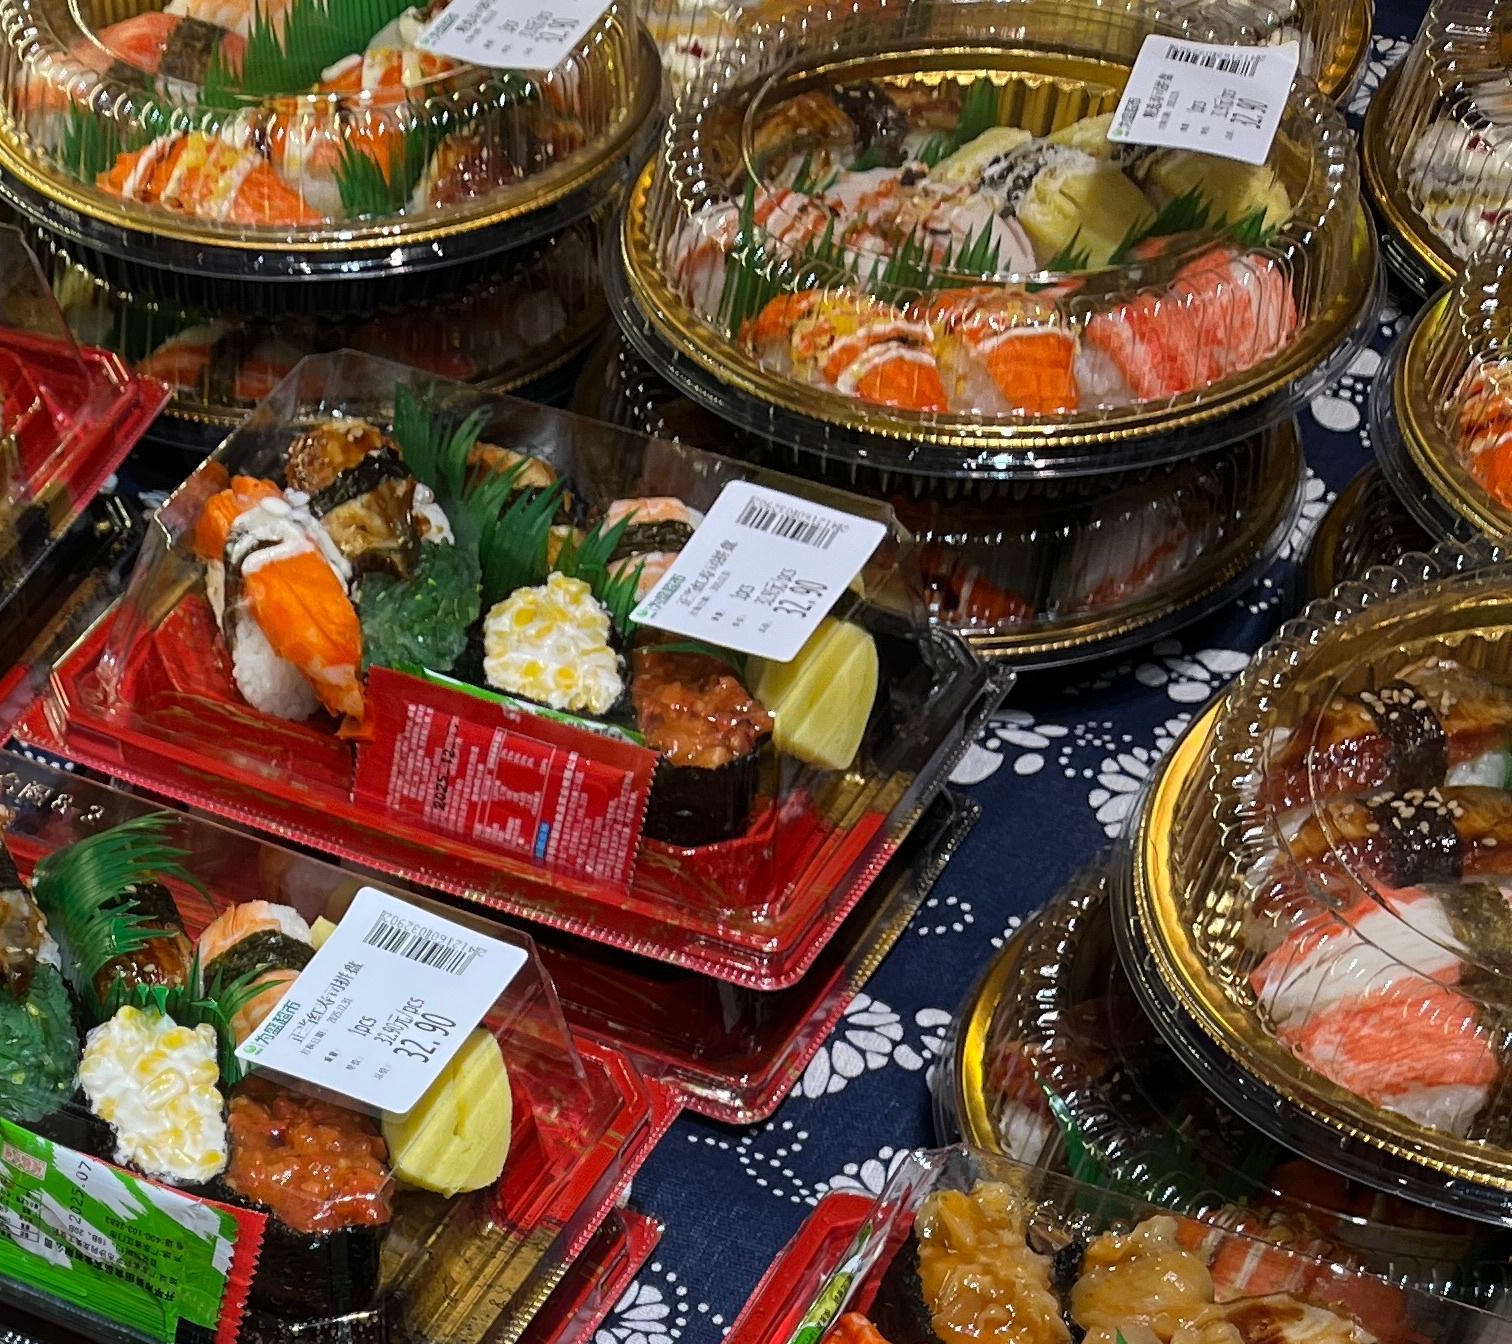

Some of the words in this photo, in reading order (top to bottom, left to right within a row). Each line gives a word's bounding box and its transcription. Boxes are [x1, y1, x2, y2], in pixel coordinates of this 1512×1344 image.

[253, 998, 301, 1045] 为盛超市
[346, 1014, 377, 1037] 1pcs
[391, 1012, 457, 1063] 32.90
